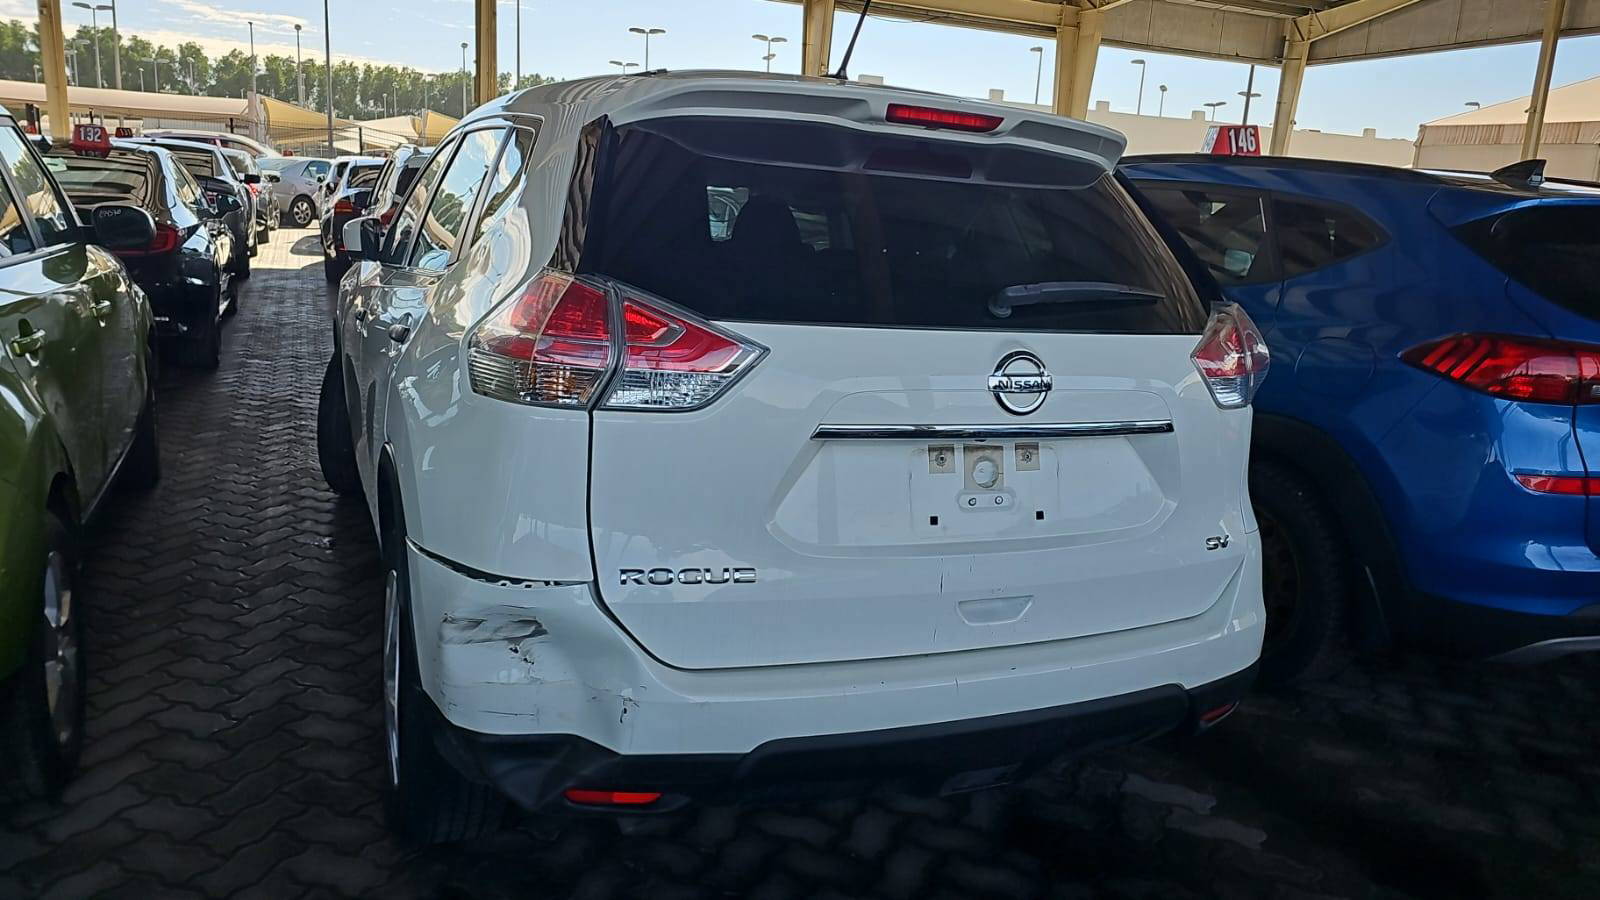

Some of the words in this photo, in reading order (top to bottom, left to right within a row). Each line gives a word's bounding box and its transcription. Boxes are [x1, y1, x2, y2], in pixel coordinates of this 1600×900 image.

[80, 127, 101, 142] 132
[1229, 127, 1256, 154] 146
[998, 380, 1051, 390] NISSAN
[1205, 534, 1230, 551] SV
[618, 567, 757, 585] ROGUE
